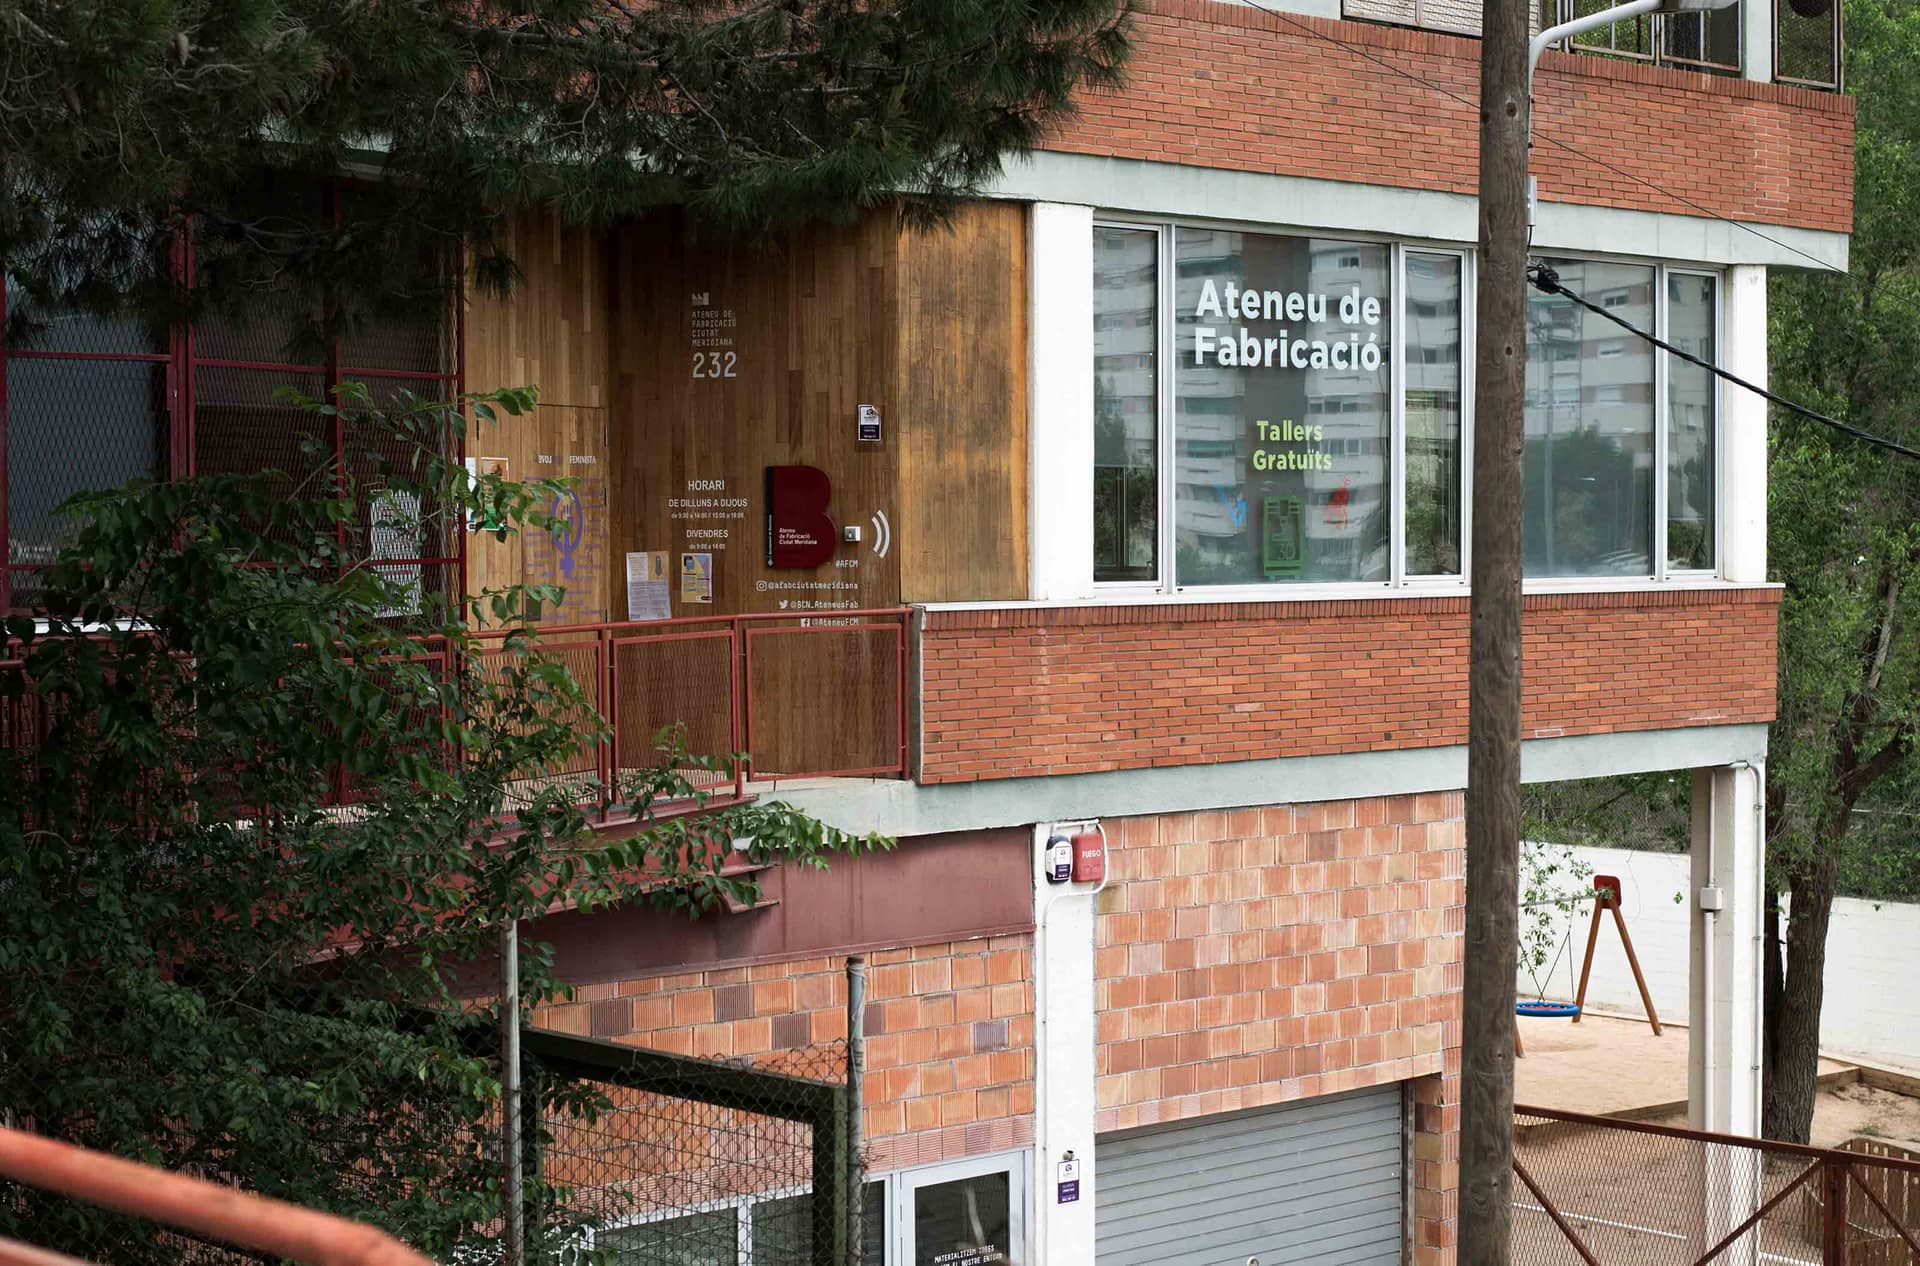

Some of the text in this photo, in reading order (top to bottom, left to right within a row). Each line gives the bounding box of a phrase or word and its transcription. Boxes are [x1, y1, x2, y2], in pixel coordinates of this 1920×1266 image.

[1195, 279, 1381, 326] Ateneu de
[692, 310, 732, 319] ATENEU DE
[692, 329, 719, 338] CIUTAT
[692, 338, 734, 347] MERIDIANA
[1194, 327, 1381, 371] Fabricació
[692, 351, 737, 378] 232
[1256, 419, 1323, 441] Tallers
[569, 455, 597, 464] FEMINISTA
[1253, 449, 1332, 471] Gratuïts
[688, 480, 725, 491] HORARI
[668, 498, 748, 508] DE DILLUNS A DIJOUS
[686, 529, 729, 538] DIVENDRES
[836, 559, 859, 568] #AFCM
[1082, 849, 1101, 858] FUEGO
[934, 1247, 977, 1264] MATERIALITZEM
